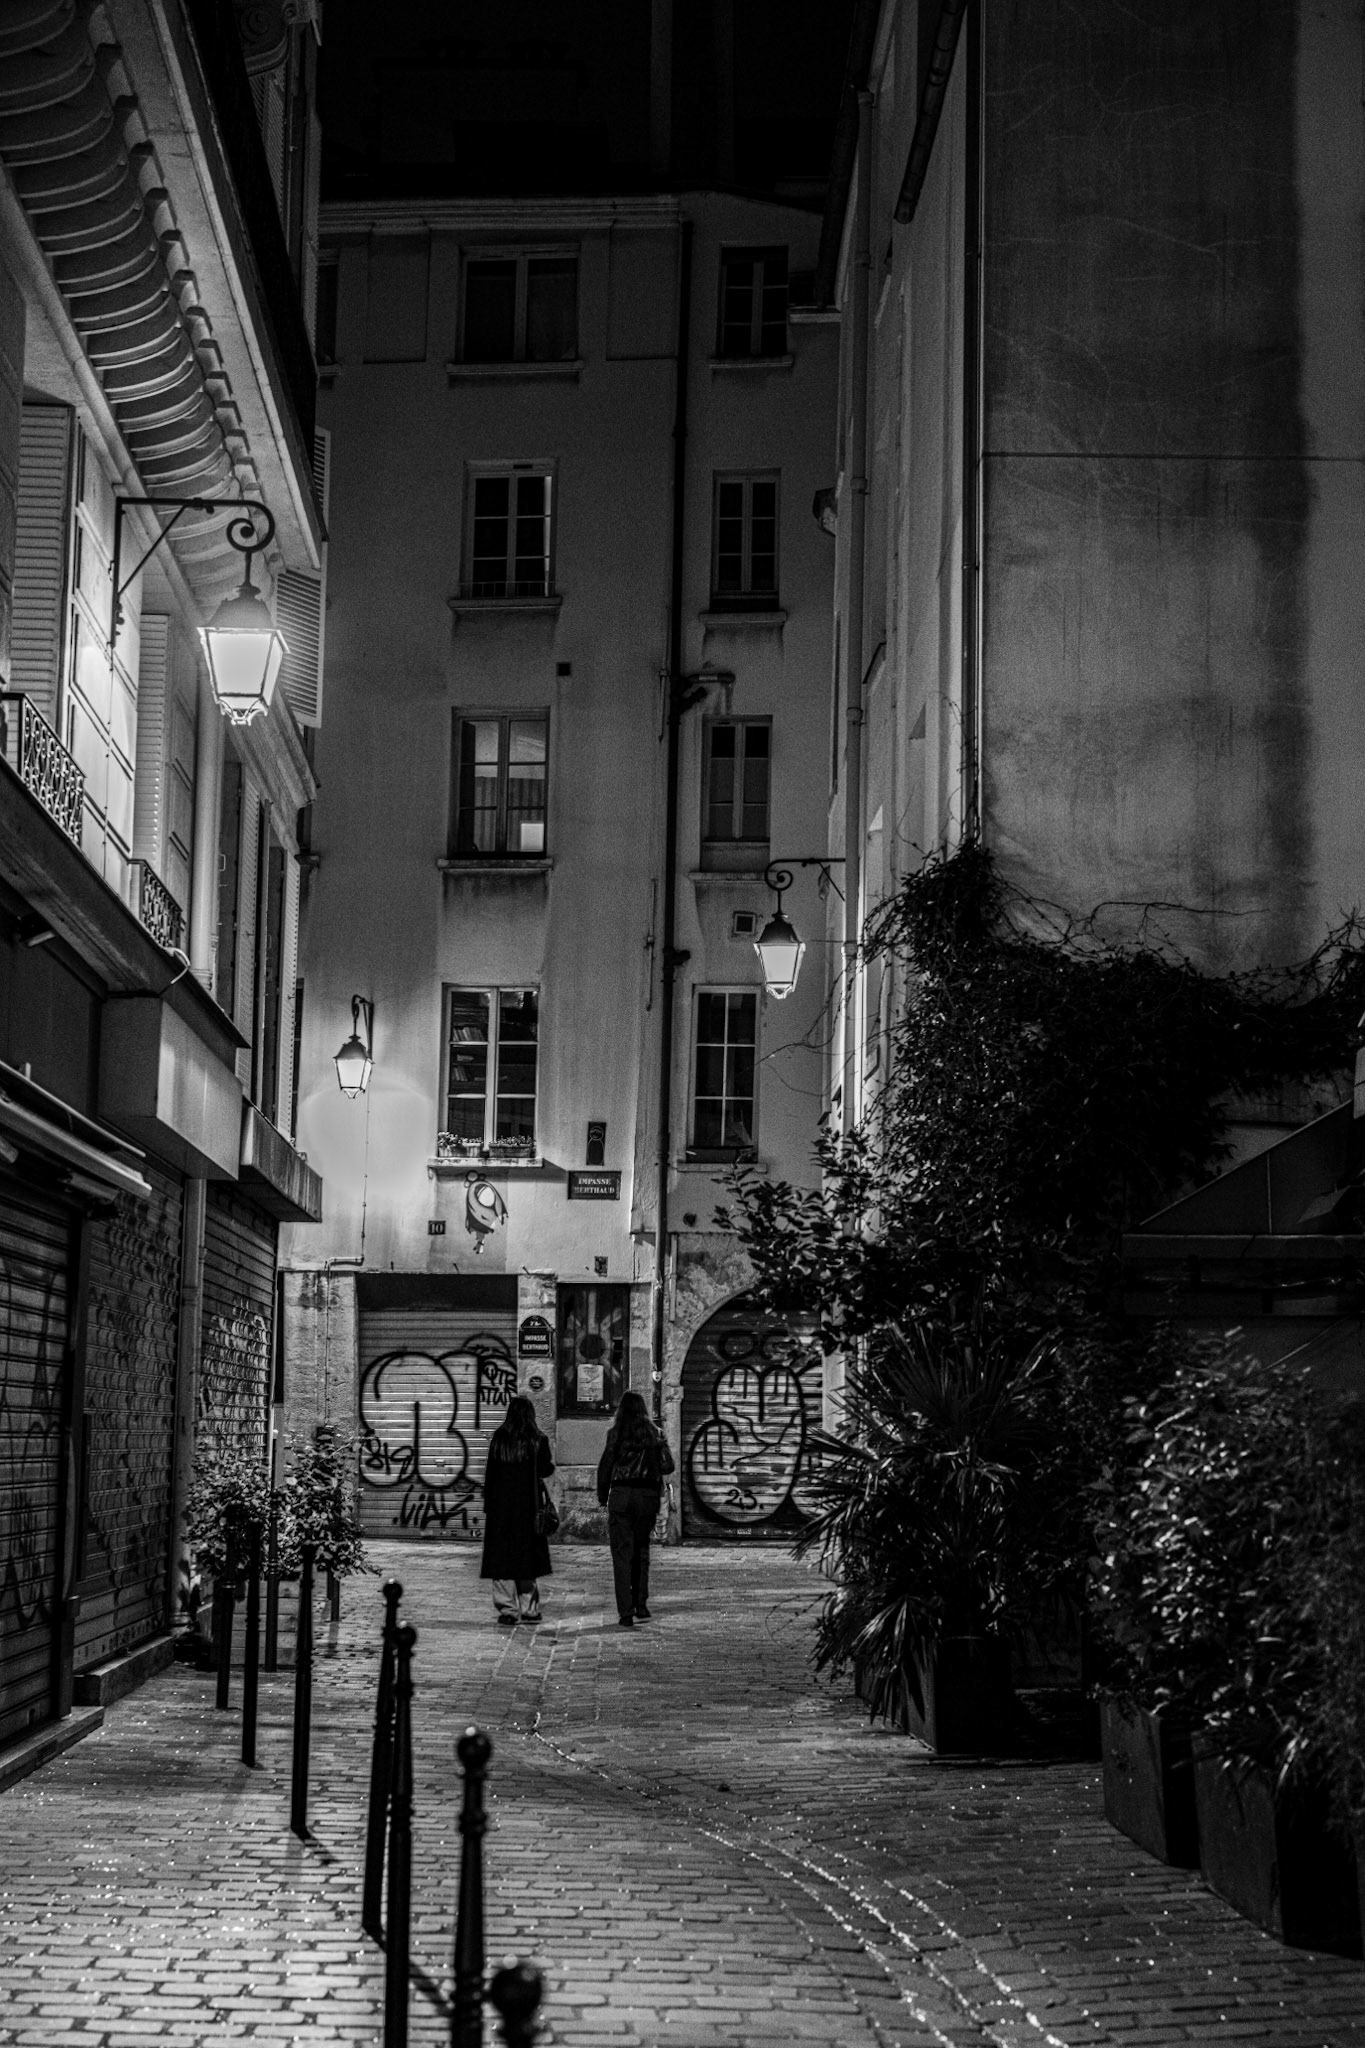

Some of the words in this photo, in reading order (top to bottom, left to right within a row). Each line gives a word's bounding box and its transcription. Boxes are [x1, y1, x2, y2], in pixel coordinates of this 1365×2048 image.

[574, 1186, 615, 1194] BERTHAUD
[431, 1223, 444, 1234] 10
[525, 1334, 547, 1342] IMPASSE
[522, 1343, 549, 1351] BERTHAUD
